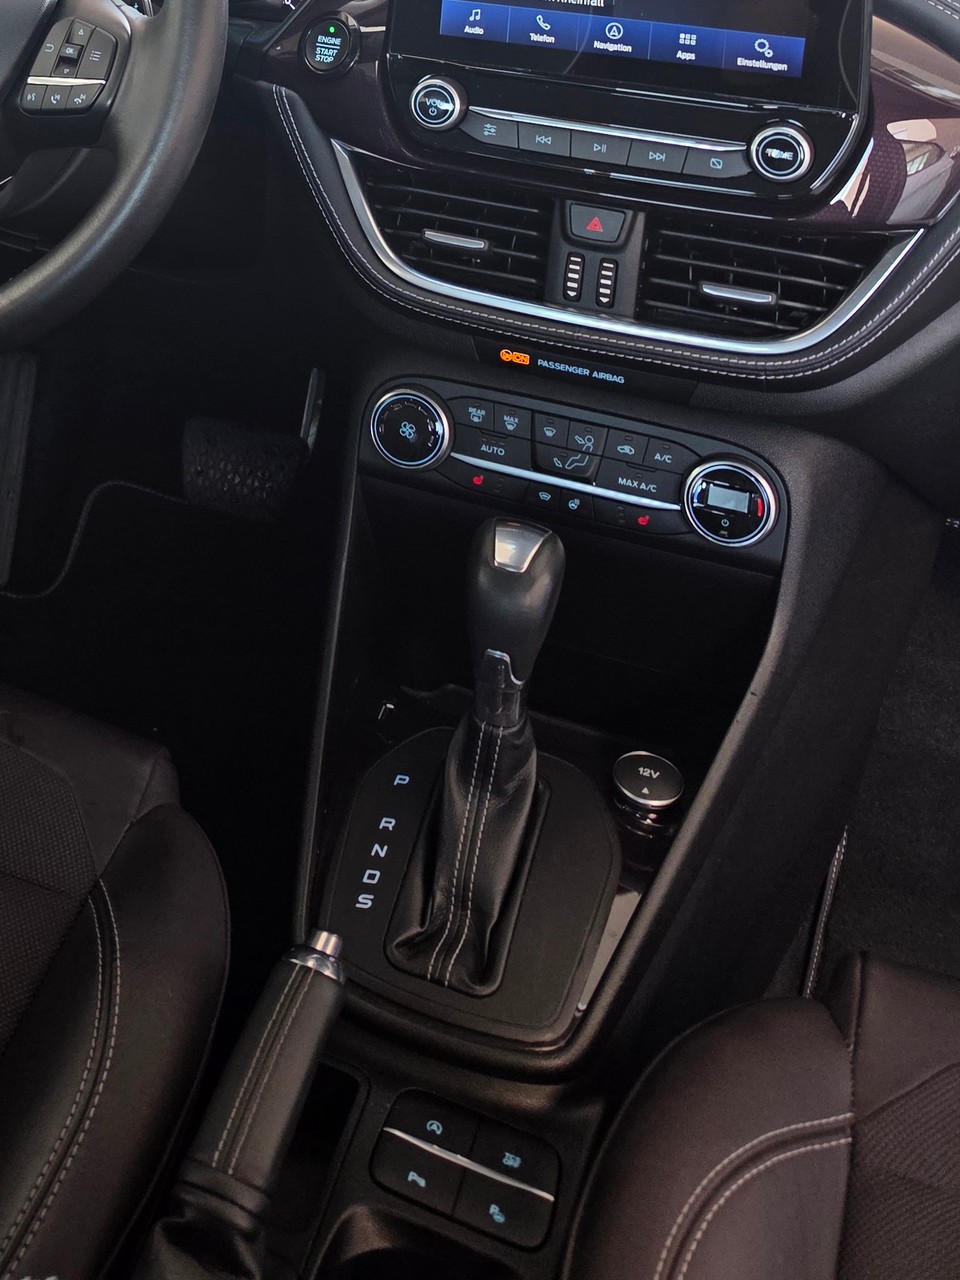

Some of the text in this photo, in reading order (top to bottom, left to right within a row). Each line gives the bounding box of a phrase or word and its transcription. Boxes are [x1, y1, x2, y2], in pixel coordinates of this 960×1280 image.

[464, 25, 484, 35] Audio
[317, 35, 342, 45] ENGINE
[529, 32, 555, 44] Telefon
[315, 47, 338, 56] START
[593, 40, 632, 53] Navigation
[314, 54, 334, 63] STOP
[676, 50, 696, 61] Apps
[736, 57, 788, 71] Einstellungen
[537, 359, 625, 384] PASSENGER AIRBAG
[503, 415, 519, 424] MAX
[480, 444, 505, 456] AUTO
[654, 452, 673, 463] A/C
[618, 477, 657, 493] MAX A/C
[637, 766, 660, 779] 12V
[393, 774, 410, 786] P
[378, 817, 396, 831] R
[370, 843, 388, 858] N
[362, 869, 381, 884] D
[355, 893, 374, 909] S
